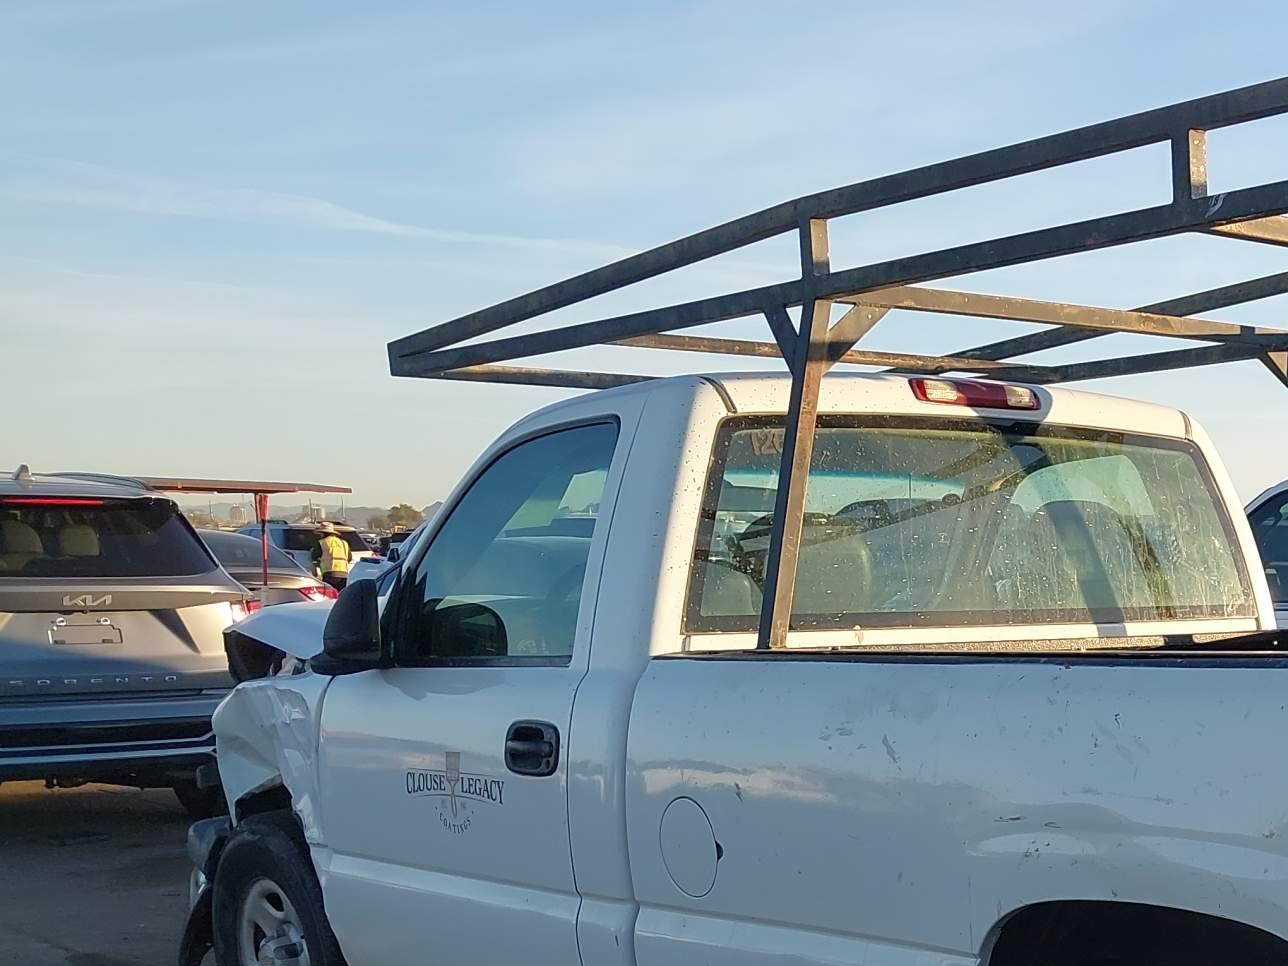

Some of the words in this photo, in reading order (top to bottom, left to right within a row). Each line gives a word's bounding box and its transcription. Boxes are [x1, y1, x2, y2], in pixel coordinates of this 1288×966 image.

[63, 594, 113, 606] KIA
[9, 675, 178, 686] SORENTO
[406, 771, 446, 794] CLOUSE
[460, 776, 505, 805] LEGACY
[439, 812, 472, 834] COATINGS
